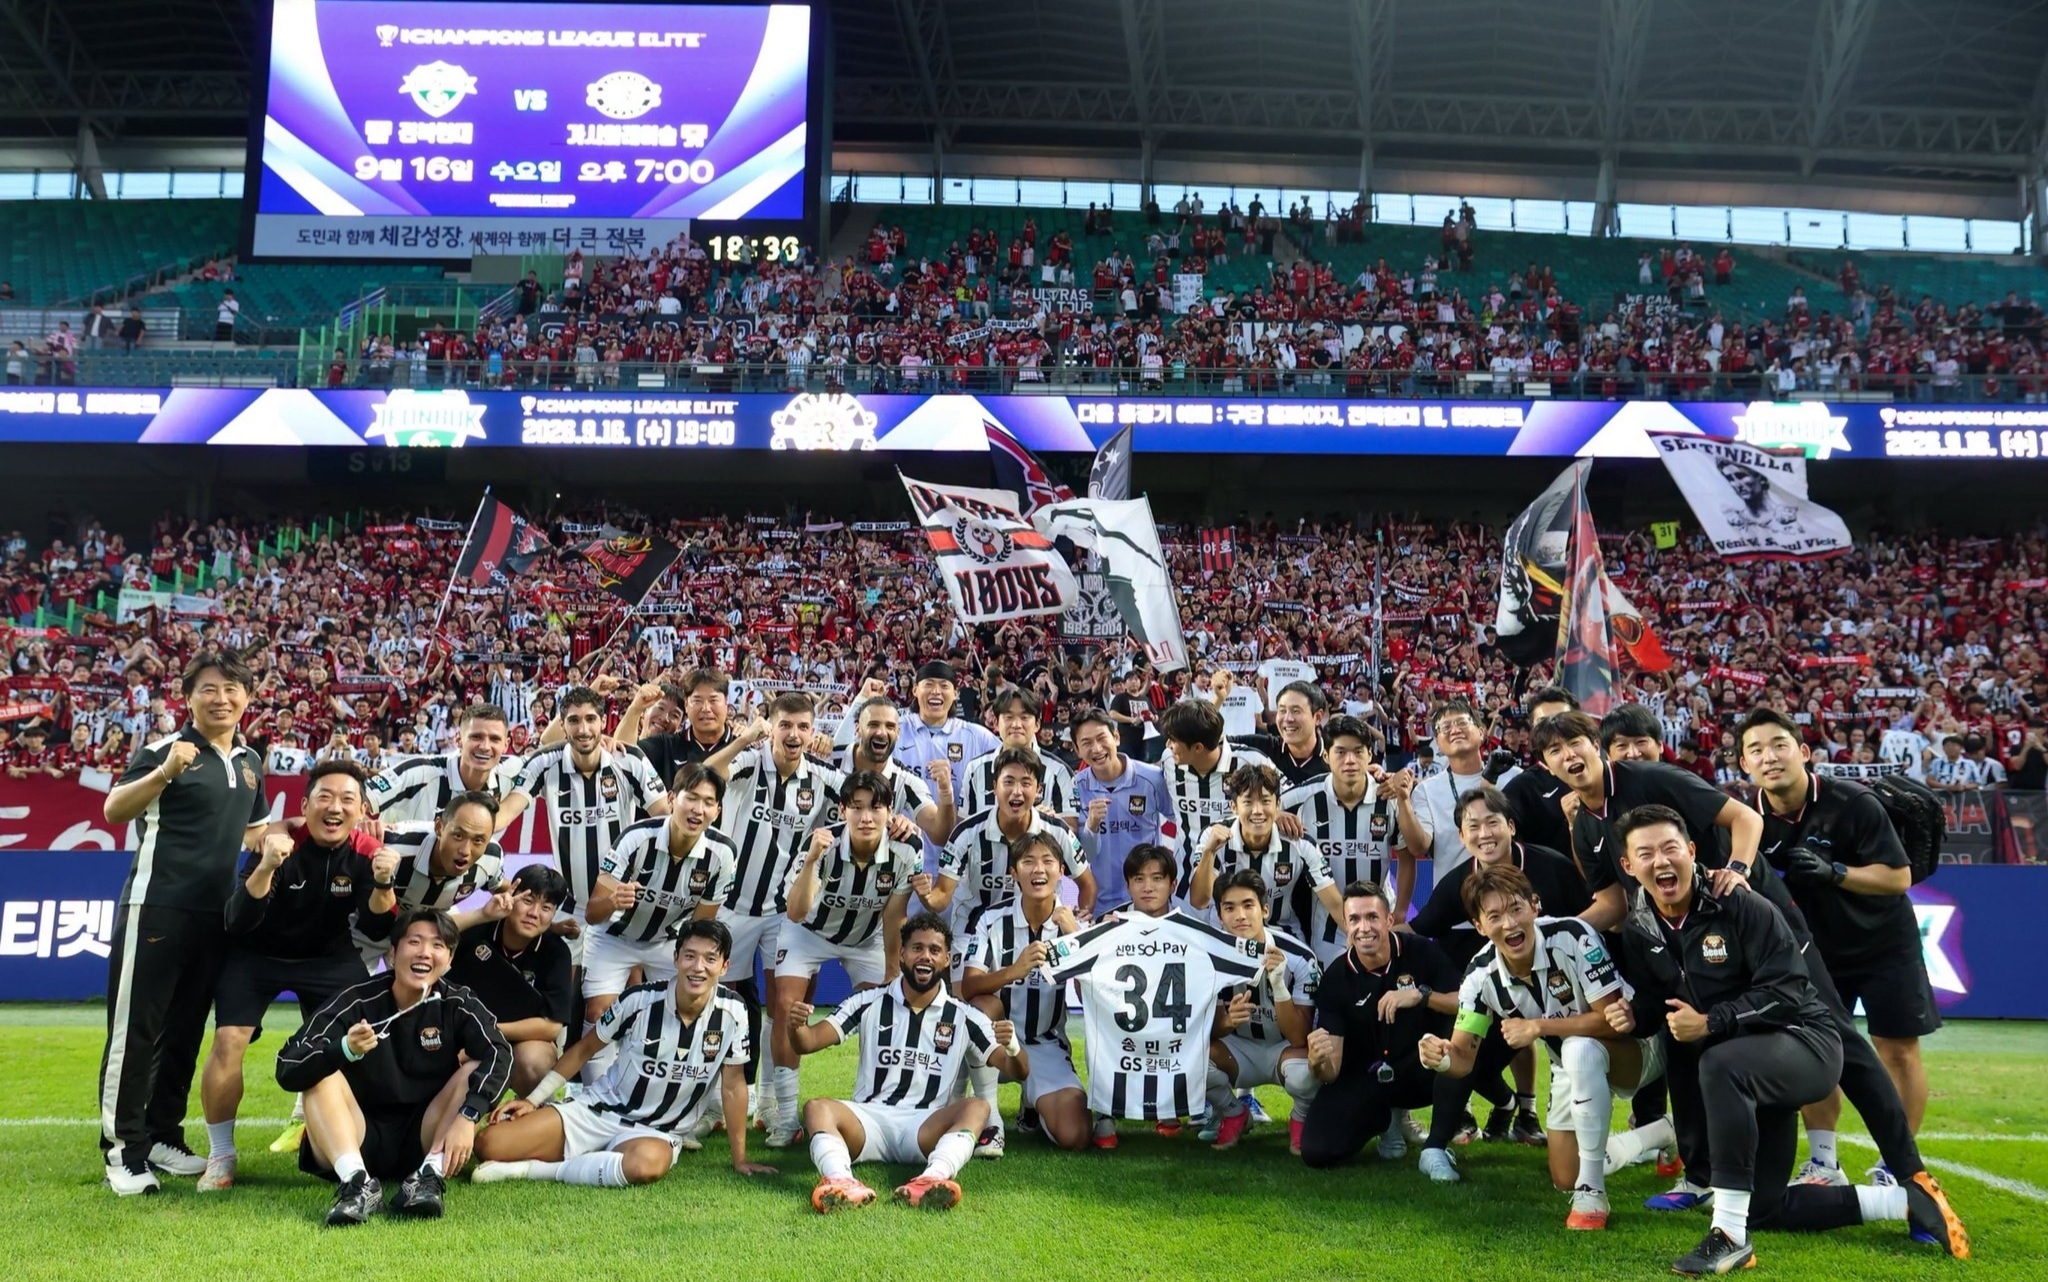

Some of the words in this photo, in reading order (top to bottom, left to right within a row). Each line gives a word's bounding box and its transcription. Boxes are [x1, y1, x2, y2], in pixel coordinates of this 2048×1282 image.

[548, 31, 634, 47] LEAGUE
[638, 33, 700, 47] ELITE
[514, 89, 547, 111] VS
[355, 155, 402, 181] 9월
[410, 156, 473, 182] 16일
[489, 161, 561, 182] 수요일
[634, 158, 715, 184] 7:00
[297, 229, 342, 245] 도민과
[346, 229, 375, 245] 함께
[379, 225, 464, 248] 체감성장,
[468, 230, 513, 247] 세계와
[517, 230, 547, 247] 함께
[552, 227, 572, 248] 더
[579, 228, 598, 248] 큰
[606, 227, 647, 248] 전북
[1032, 288, 1087, 302] ULTRAS
[1625, 294, 1642, 304] WE
[1646, 294, 1672, 304] CAN
[1057, 301, 1093, 313] TOUR
[634, 400, 692, 414] LEAGUE
[693, 401, 735, 414] ELITE
[676, 420, 735, 445] 19:00
[1660, 527, 1672, 537] 31
[974, 563, 1062, 614] BOYS
[1255, 580, 1270, 594] 22
[655, 629, 669, 643] 16
[1063, 621, 1090, 635] 1983
[1093, 622, 1122, 636] 2004
[715, 648, 735, 665] 34
[1717, 666, 1730, 677] FC
[1732, 670, 1767, 685] SEOUL
[1834, 766, 1860, 778] 승점
[1178, 799, 1197, 812] GS
[1200, 800, 1232, 814] 칼텍스
[560, 810, 583, 825] GS
[751, 805, 771, 822] GS
[772, 810, 806, 830] 칼텍스
[1109, 820, 1141, 834] 칼텍스
[1321, 842, 1343, 856] GS
[1345, 842, 1381, 857] 칼텍스
[982, 875, 1003, 889] GS
[635, 888, 656, 903] GS
[660, 892, 696, 910] 칼텍스
[823, 894, 845, 908] GS
[849, 895, 885, 910] 칼텍스
[0, 900, 115, 958] 티켓
[1116, 944, 1135, 958] 신한
[1163, 942, 1188, 956] Pay
[1702, 944, 1728, 957] Seoul
[1114, 963, 1192, 1034] 34
[878, 1049, 901, 1066] GS
[903, 1048, 943, 1071] 칼텍스
[1120, 1056, 1142, 1072] GS
[1145, 1057, 1181, 1073] 칼텍스
[642, 1059, 668, 1079] GS
[671, 1061, 710, 1081] 칼텍스
